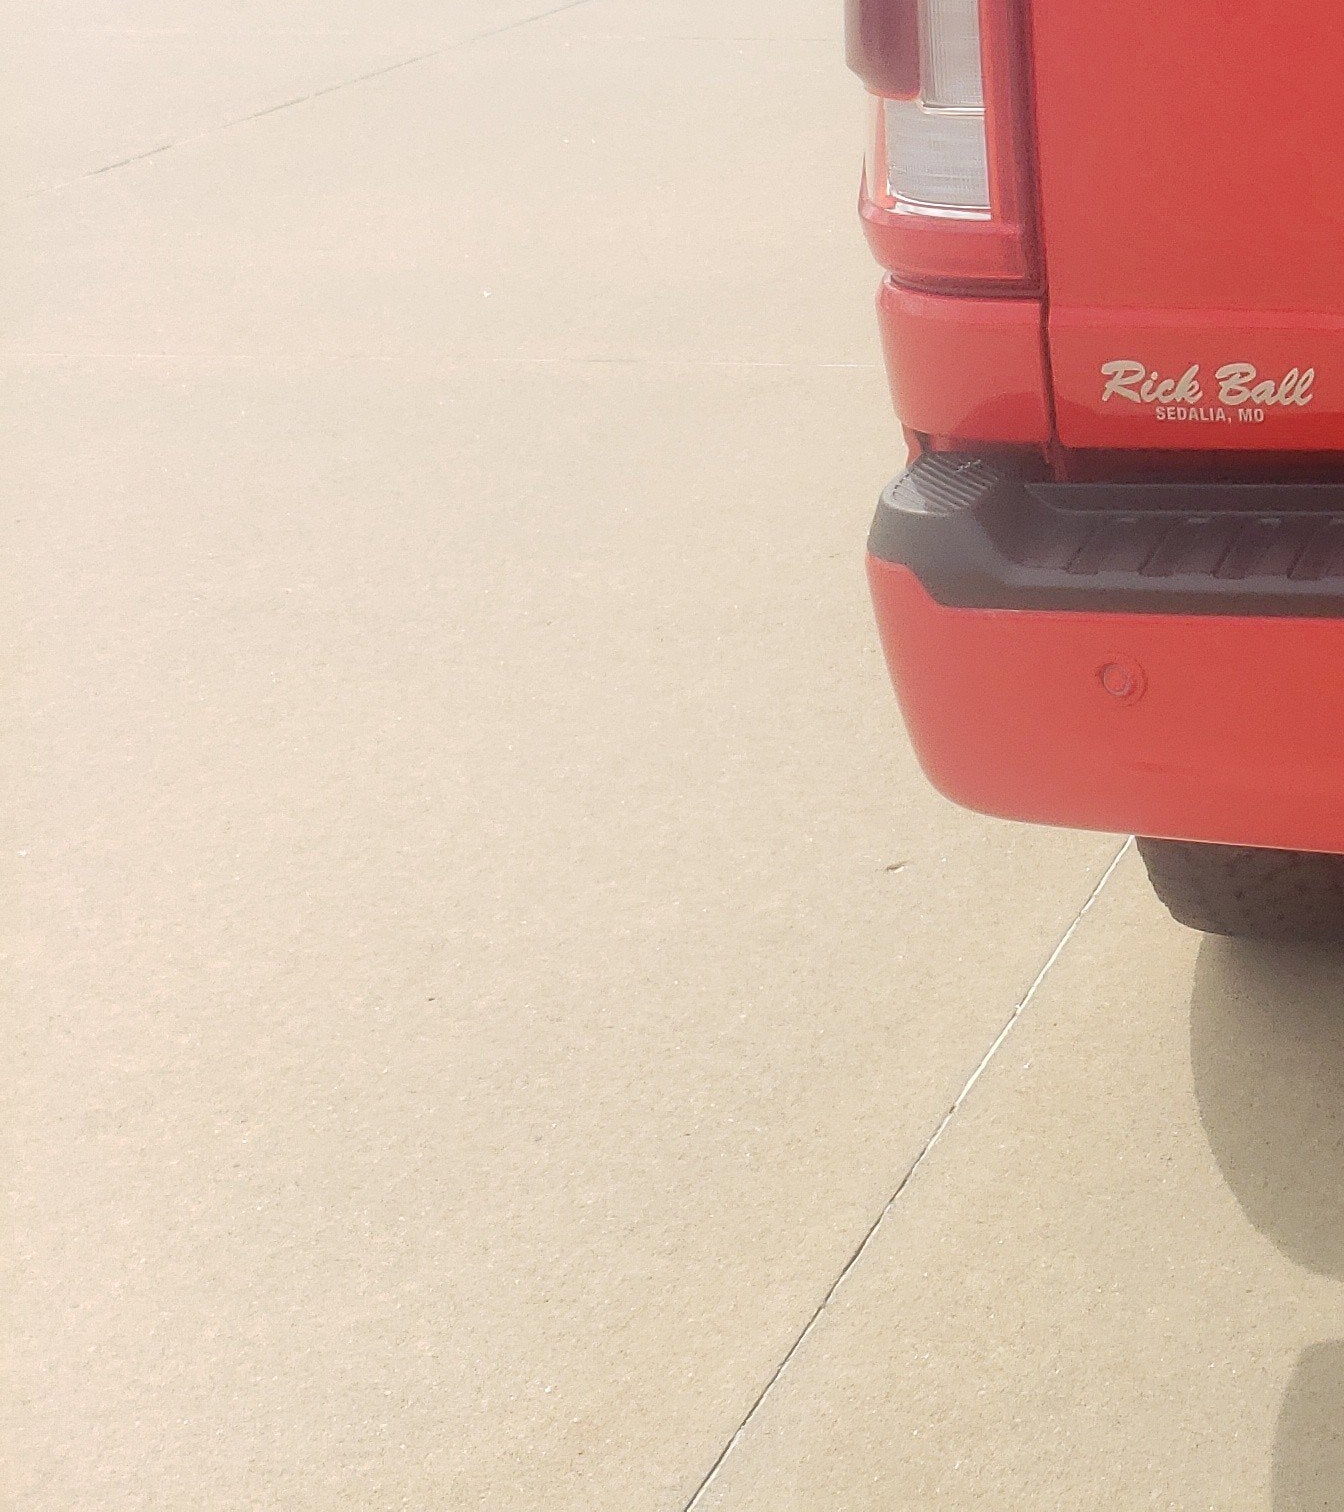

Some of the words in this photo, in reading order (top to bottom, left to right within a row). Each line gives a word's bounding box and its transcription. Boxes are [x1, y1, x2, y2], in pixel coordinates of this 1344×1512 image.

[1101, 359, 1203, 404] Rick
[1215, 362, 1315, 406] Ball
[1156, 405, 1232, 423] SEDALIA,
[1238, 407, 1265, 422] MO
